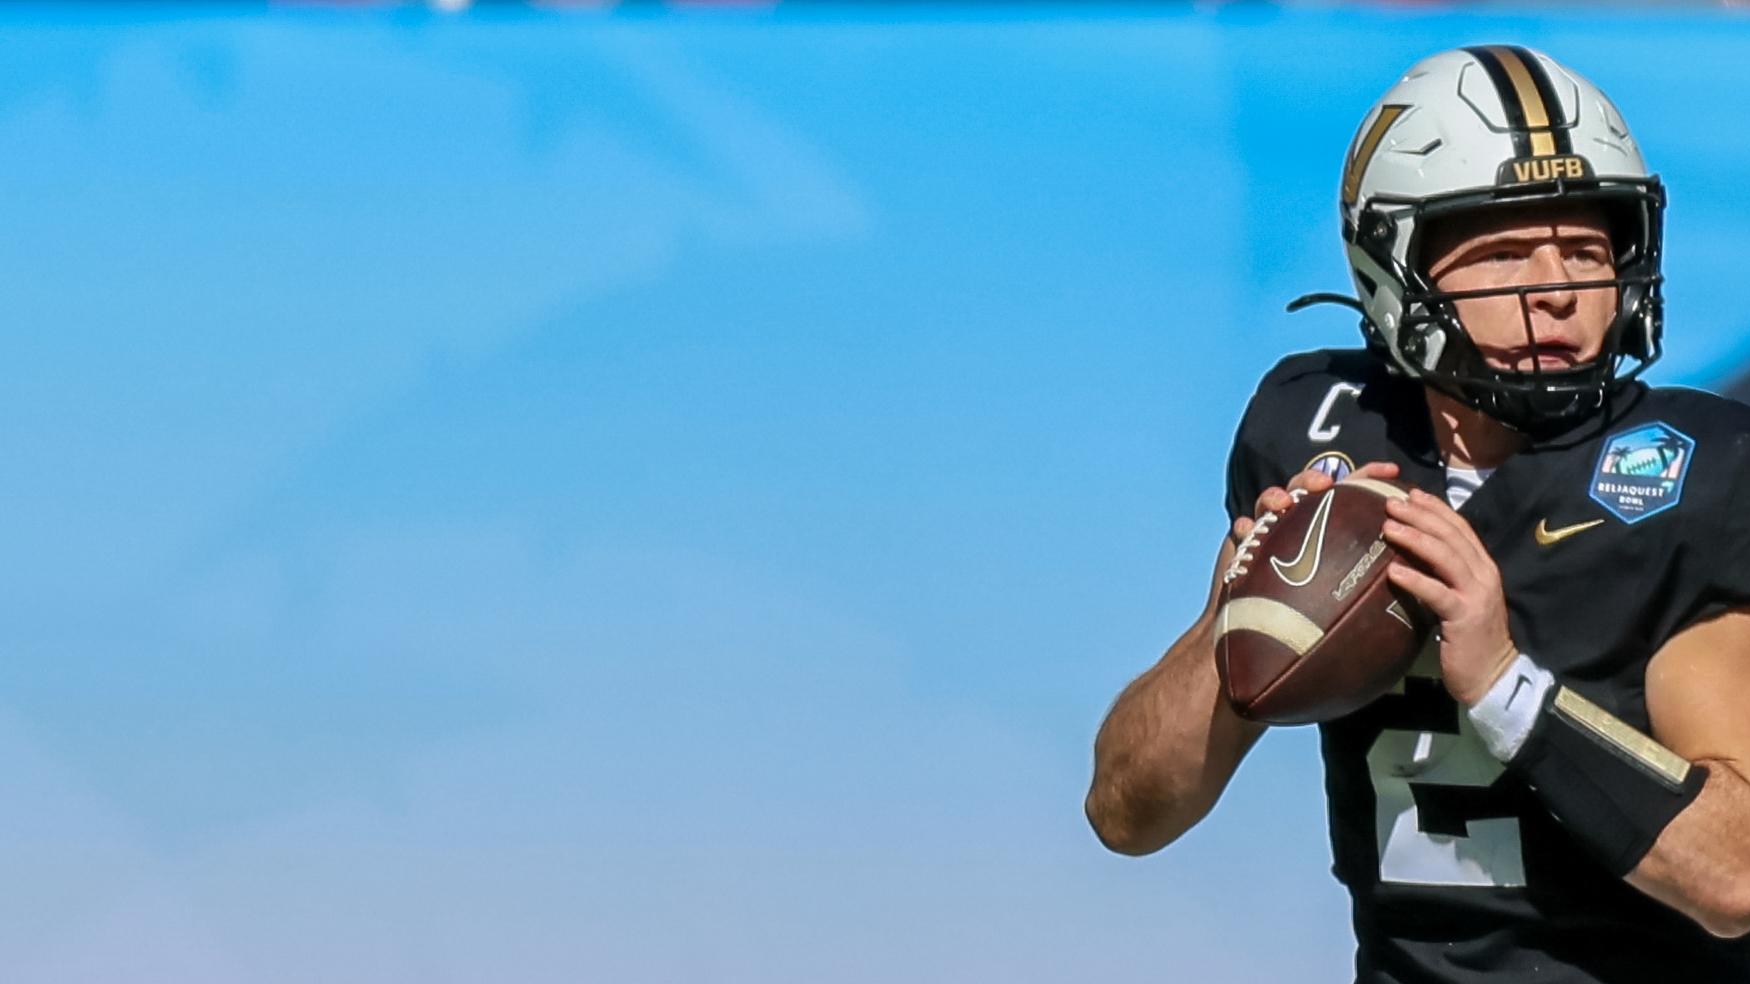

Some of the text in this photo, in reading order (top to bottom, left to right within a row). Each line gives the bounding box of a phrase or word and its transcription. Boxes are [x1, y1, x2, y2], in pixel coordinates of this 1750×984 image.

[1513, 158, 1583, 181] VUFB
[1308, 382, 1365, 442] C
[1598, 483, 1664, 497] RELIAQUEST
[1619, 496, 1644, 505] BOWL
[1366, 632, 1527, 887] 2
